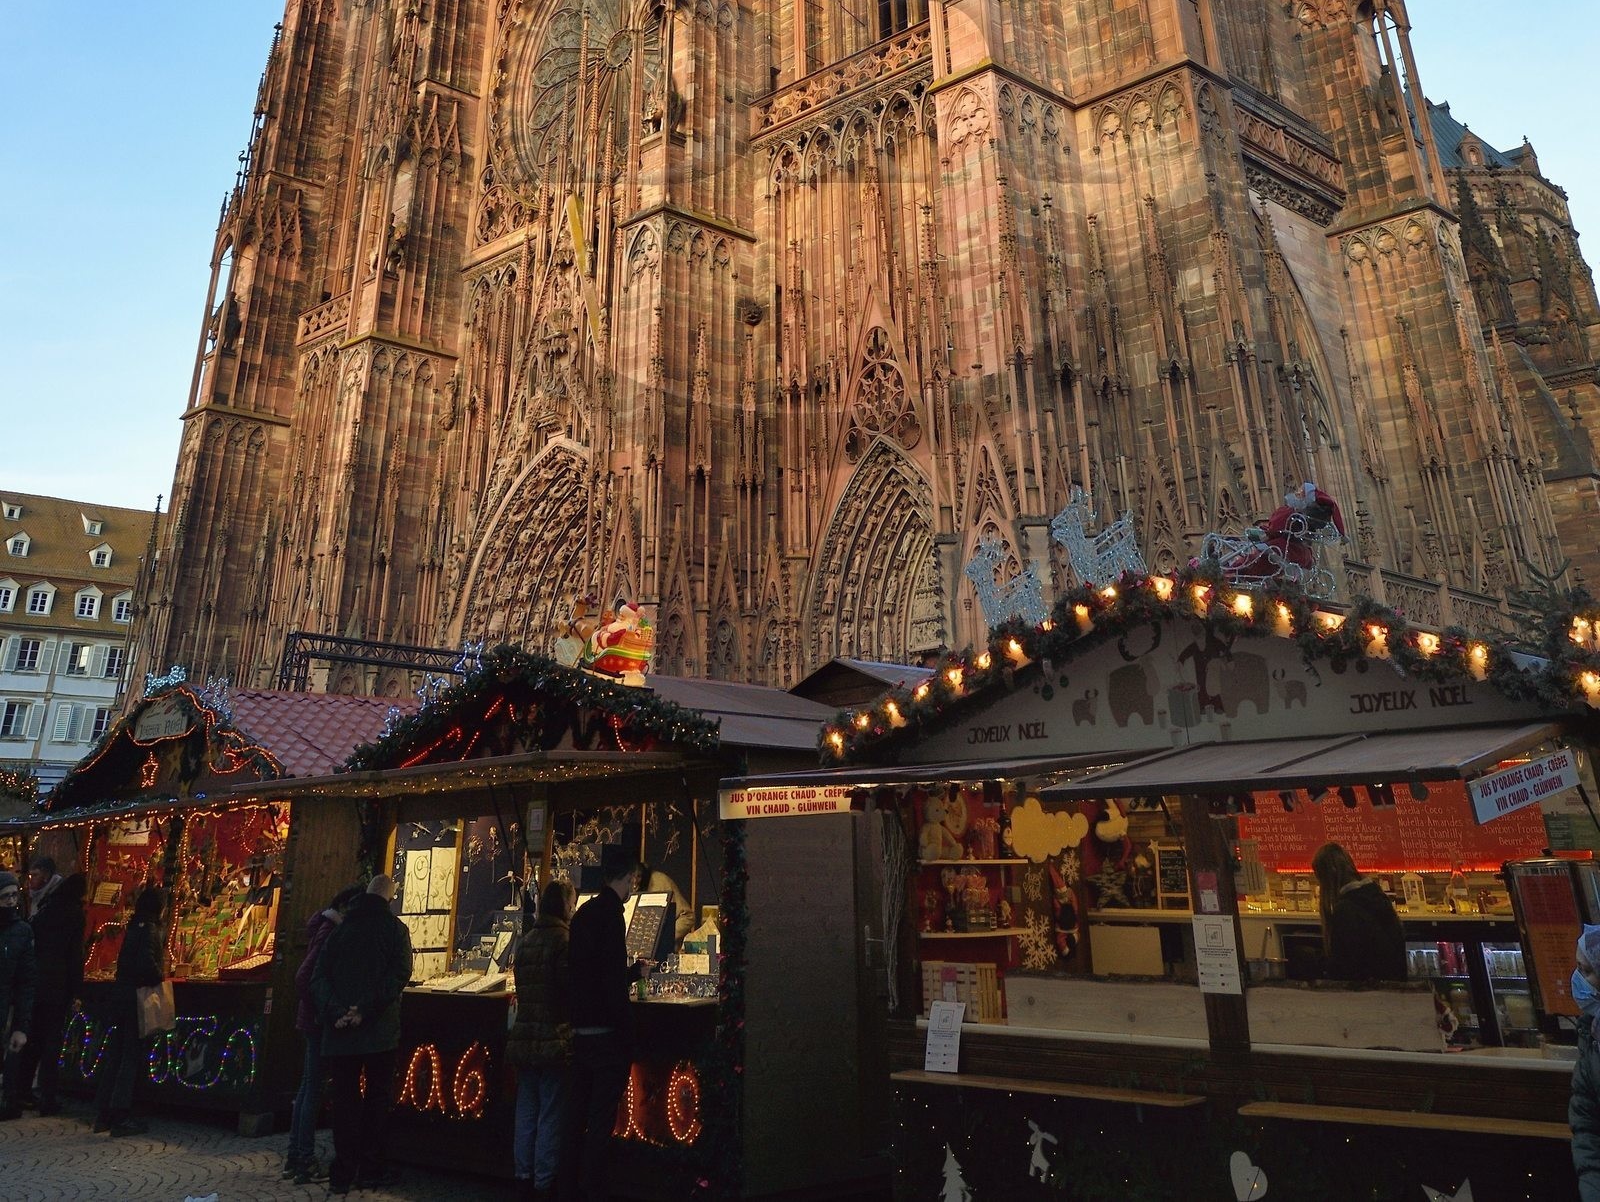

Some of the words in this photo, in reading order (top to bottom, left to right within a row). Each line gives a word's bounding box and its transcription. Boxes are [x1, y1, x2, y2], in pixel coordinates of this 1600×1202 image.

[1350, 690, 1417, 714] JOYEUX
[967, 725, 1011, 744] JOYEUX
[1480, 781, 1492, 798] JUS
[1491, 770, 1524, 793] D'ORANGE
[1523, 763, 1544, 781] CHAUD
[730, 793, 744, 803] JUS
[747, 791, 788, 802] D'ORANGE
[791, 790, 816, 799] CHAUD
[1495, 797, 1509, 811] VIN
[1508, 787, 1529, 806] CHAUD
[1533, 775, 1564, 796] GLÜHWEIN
[746, 805, 760, 815] VIN
[763, 803, 790, 814] CHAUD
[797, 800, 837, 812] GLÜHWEIN
